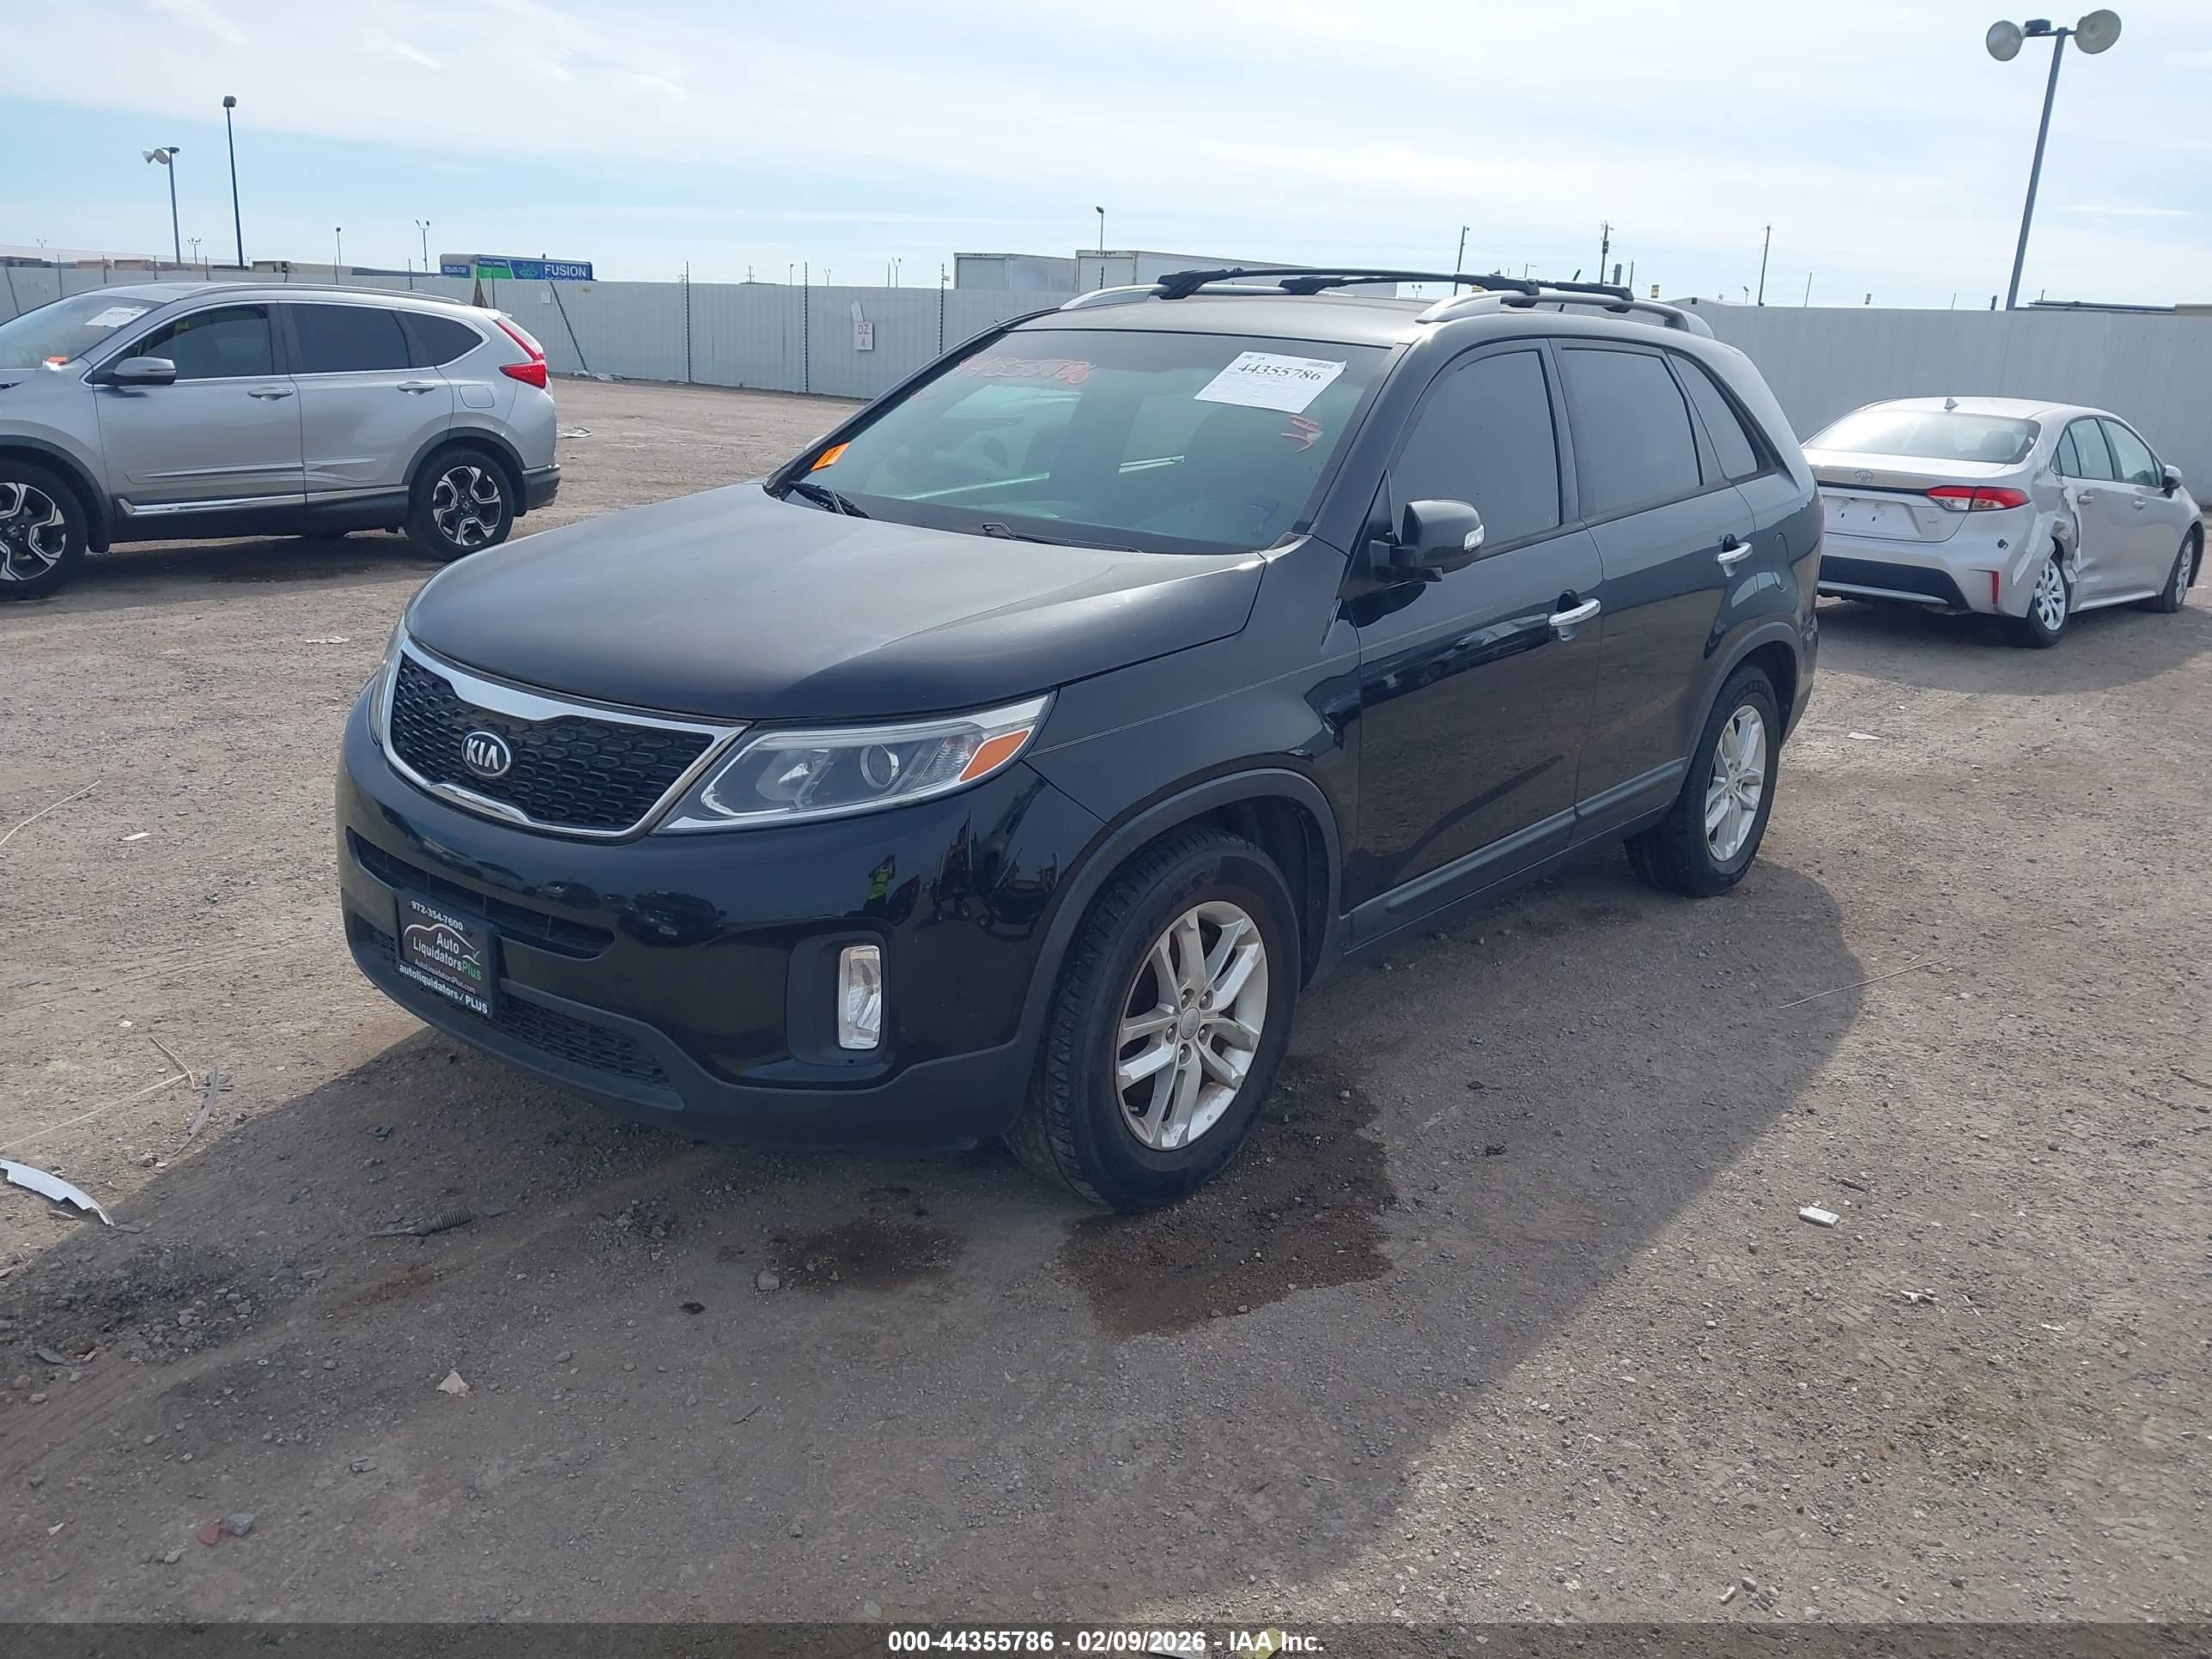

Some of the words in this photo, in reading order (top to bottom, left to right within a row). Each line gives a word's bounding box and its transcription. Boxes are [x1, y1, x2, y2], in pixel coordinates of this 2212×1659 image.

[544, 264, 586, 276] FUSION
[1237, 363, 1323, 381] 44355786
[466, 738, 499, 770] KIA
[412, 900, 464, 932] 972-354-7600
[436, 932, 459, 955] Auto
[399, 963, 459, 1001] autoliquidators
[465, 994, 488, 1014] PLUS
